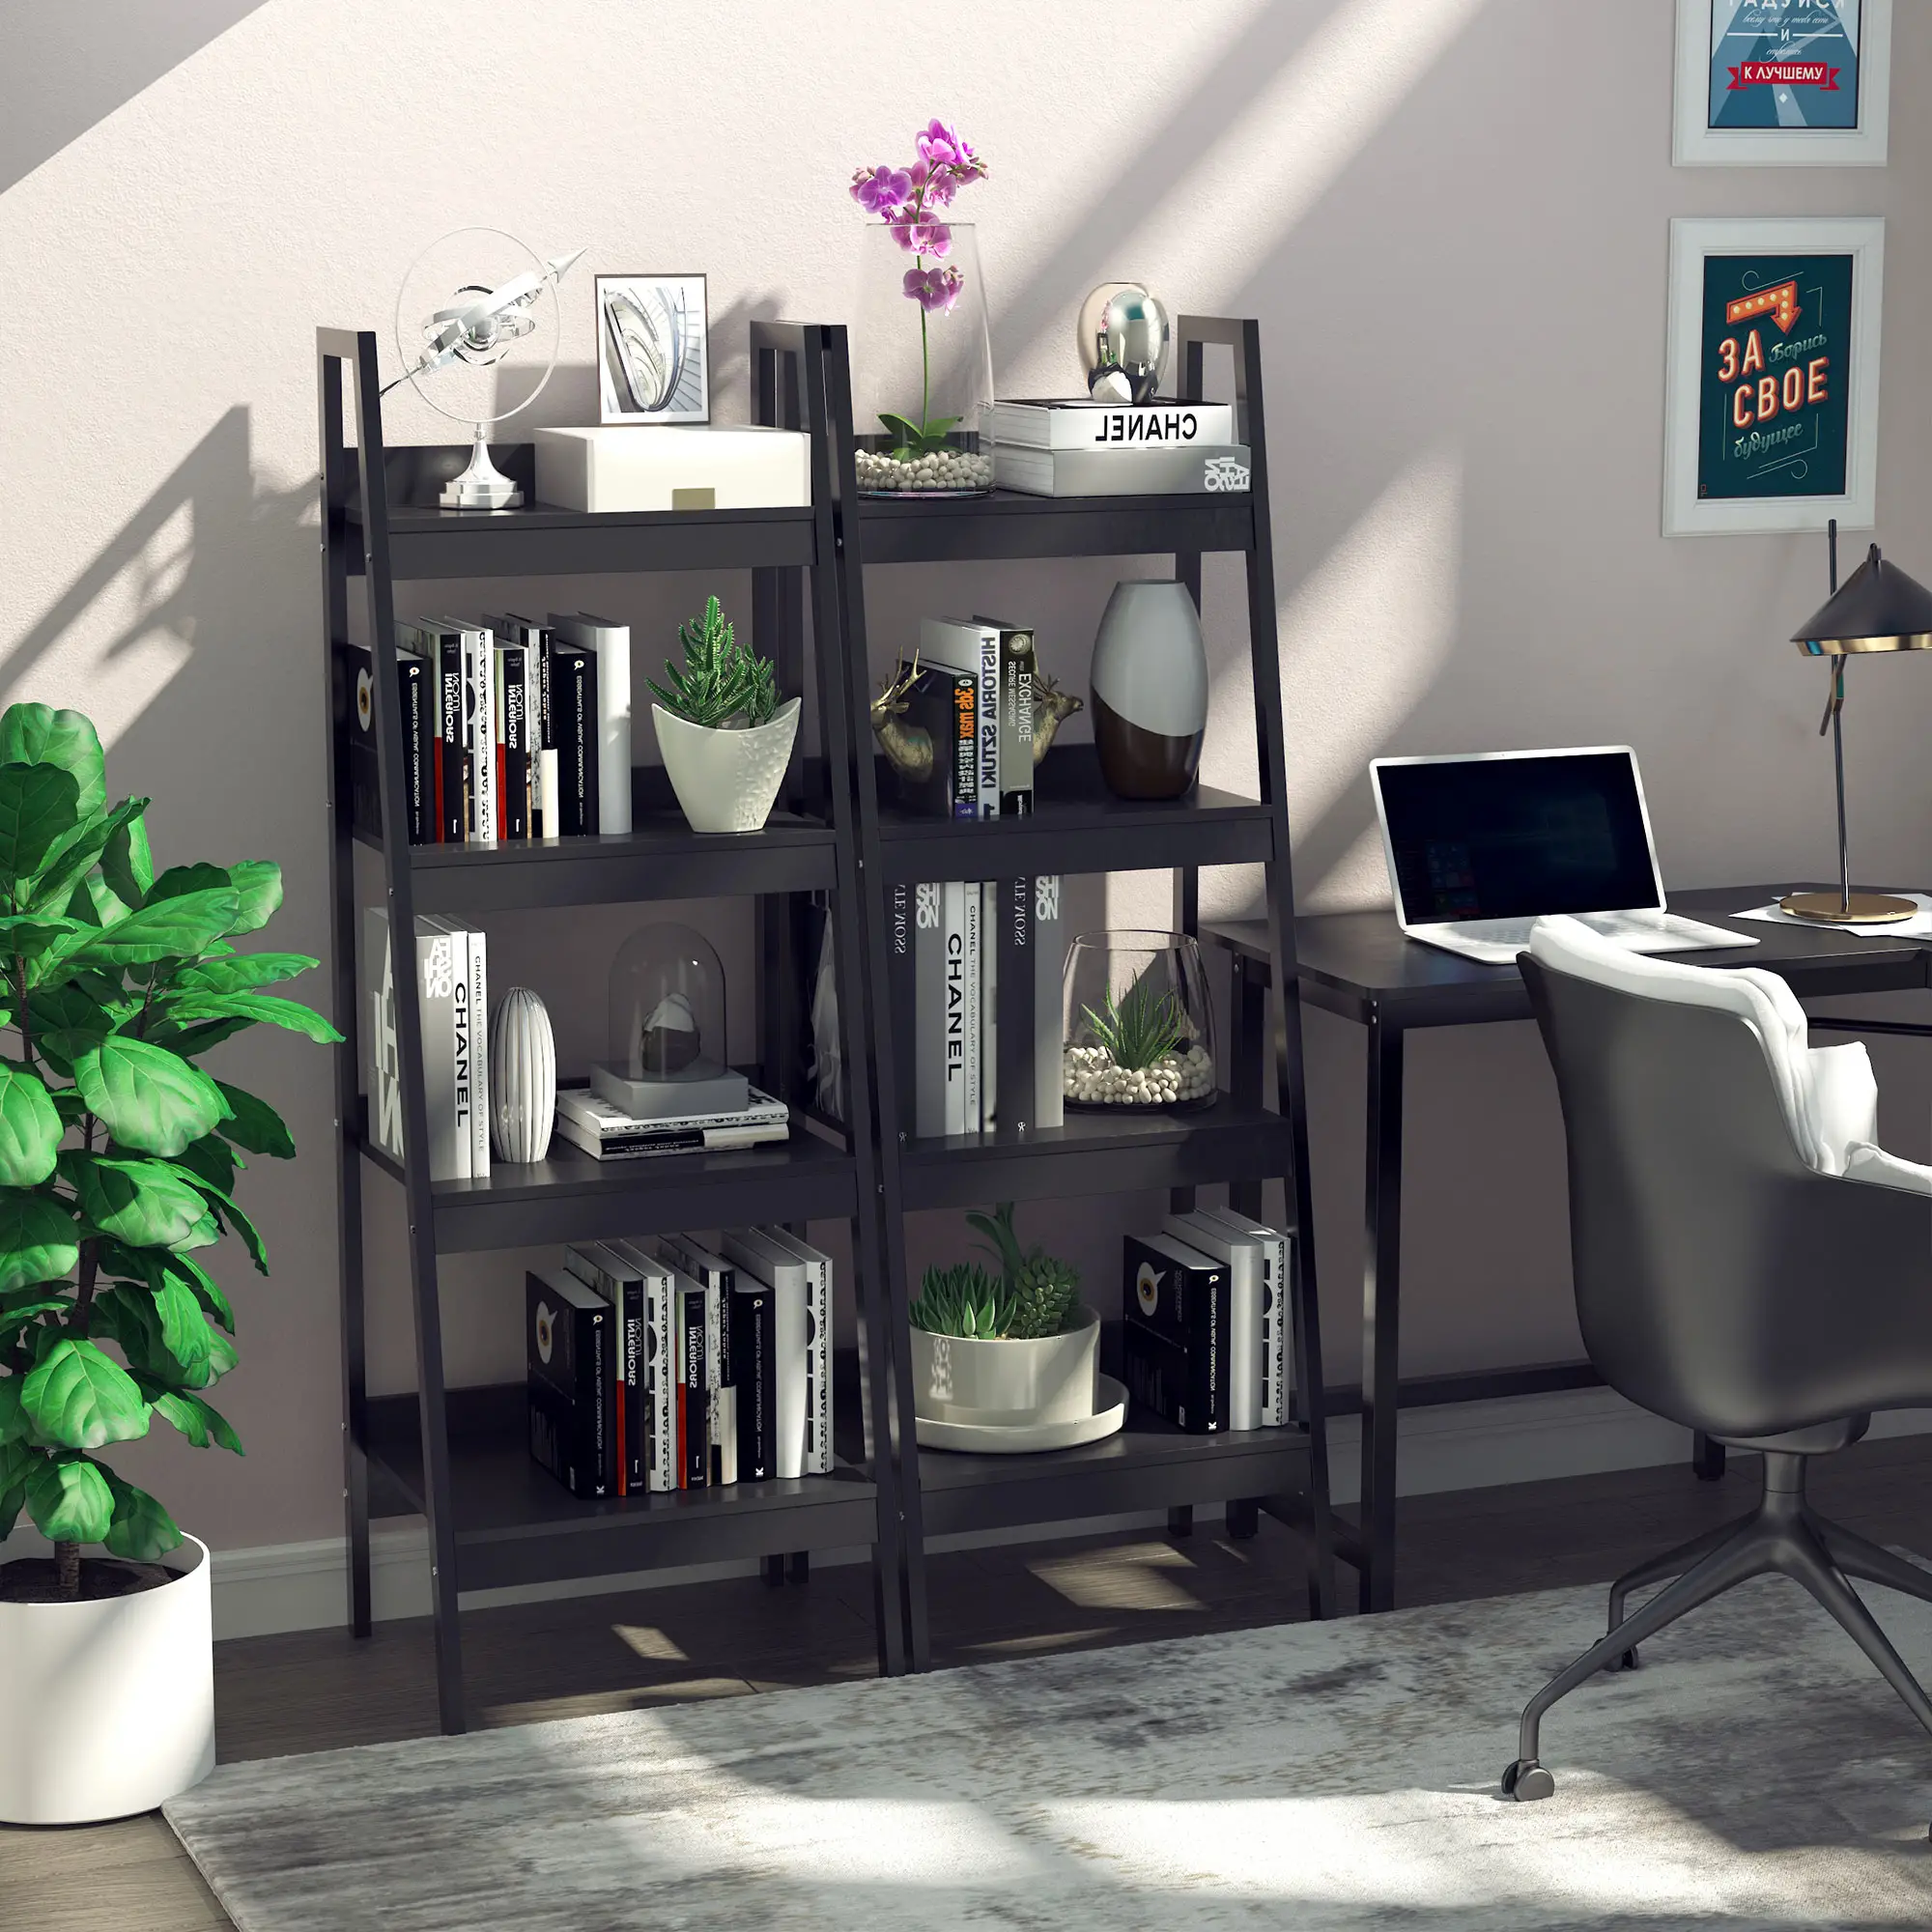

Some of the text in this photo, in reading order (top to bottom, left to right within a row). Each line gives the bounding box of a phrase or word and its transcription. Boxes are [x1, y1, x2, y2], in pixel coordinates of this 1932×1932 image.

[1744, 66, 1824, 81] К ЛУЧШЕМУ
[1718, 328, 1766, 384] ЗА
[1769, 333, 1829, 364] Борись
[1732, 355, 1831, 430] СВОЕ
[1734, 423, 1804, 461] будущее
[948, 932, 962, 1082] CHANEL
[454, 982, 469, 1127] CHANEL
[970, 1057, 976, 1070] OF
[477, 1104, 484, 1117] OF
